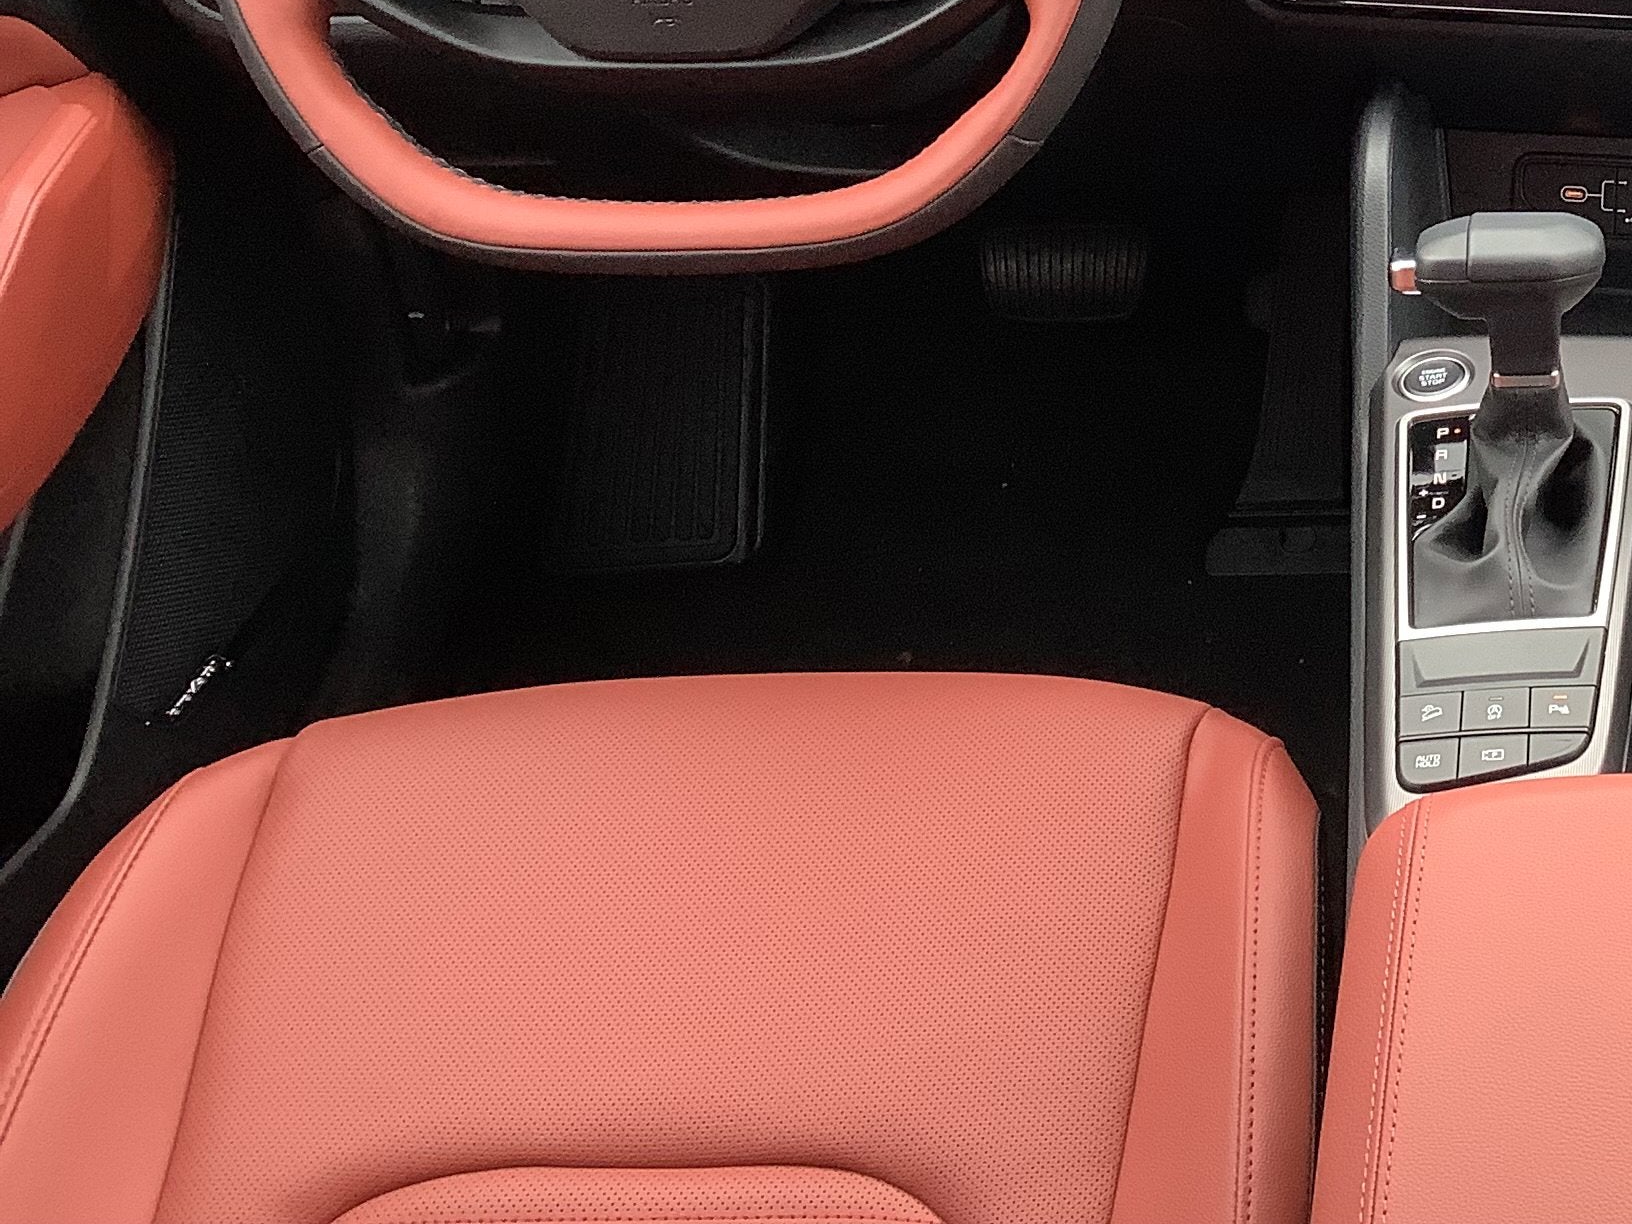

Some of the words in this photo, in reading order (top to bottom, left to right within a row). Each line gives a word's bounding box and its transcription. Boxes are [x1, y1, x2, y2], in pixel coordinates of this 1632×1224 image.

[1418, 372, 1448, 382] START
[1420, 378, 1446, 387] STOP
[1436, 427, 1449, 439] P
[1433, 472, 1447, 485] N
[1431, 497, 1446, 510] D
[1416, 753, 1441, 762] AUTO
[1415, 759, 1441, 769] HOLD
